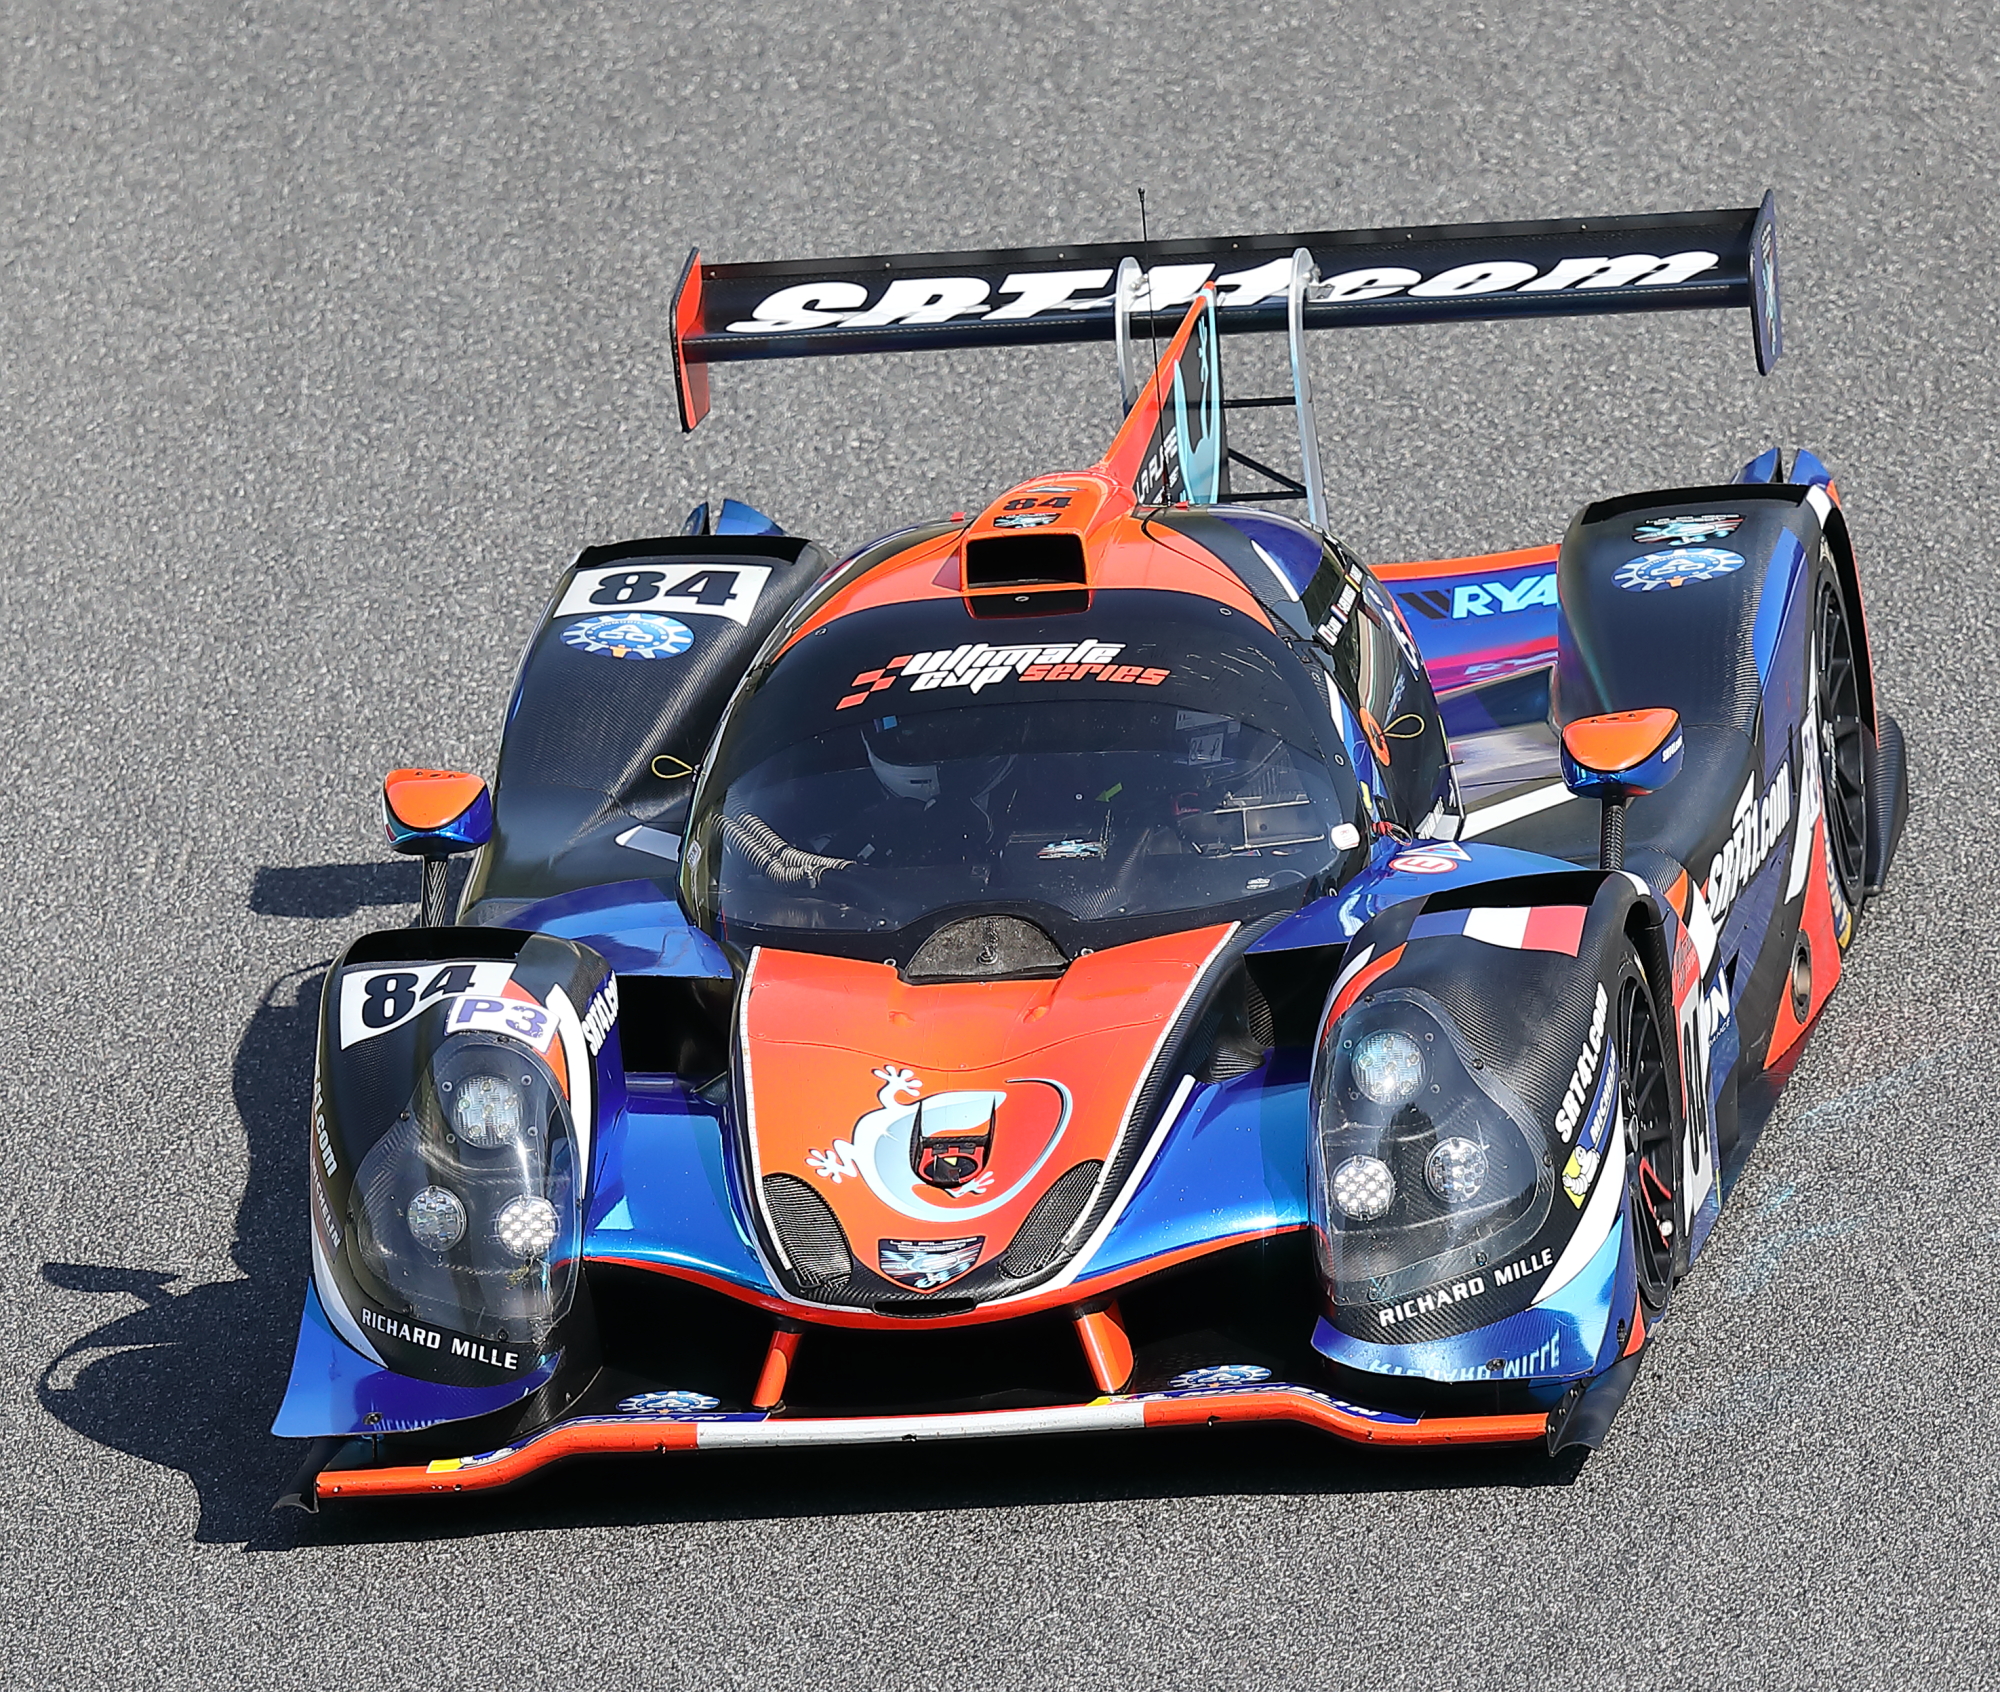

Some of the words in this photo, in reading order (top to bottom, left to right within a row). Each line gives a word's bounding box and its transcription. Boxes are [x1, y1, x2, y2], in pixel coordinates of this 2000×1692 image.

[726, 251, 1719, 334] SRT41com
[1003, 497, 1073, 511] 84
[589, 570, 739, 606] 84
[1706, 760, 1793, 920] SRT41.com
[361, 965, 476, 1030] 84
[457, 998, 548, 1039] P3
[1554, 981, 1609, 1144] SRT41.com
[311, 1157, 341, 1249] MICHELIN
[1378, 1276, 1485, 1328] RICHARD
[1494, 1247, 1554, 1287] MILLE
[361, 1307, 441, 1350] RICHARD
[451, 1337, 520, 1371] MILLE
